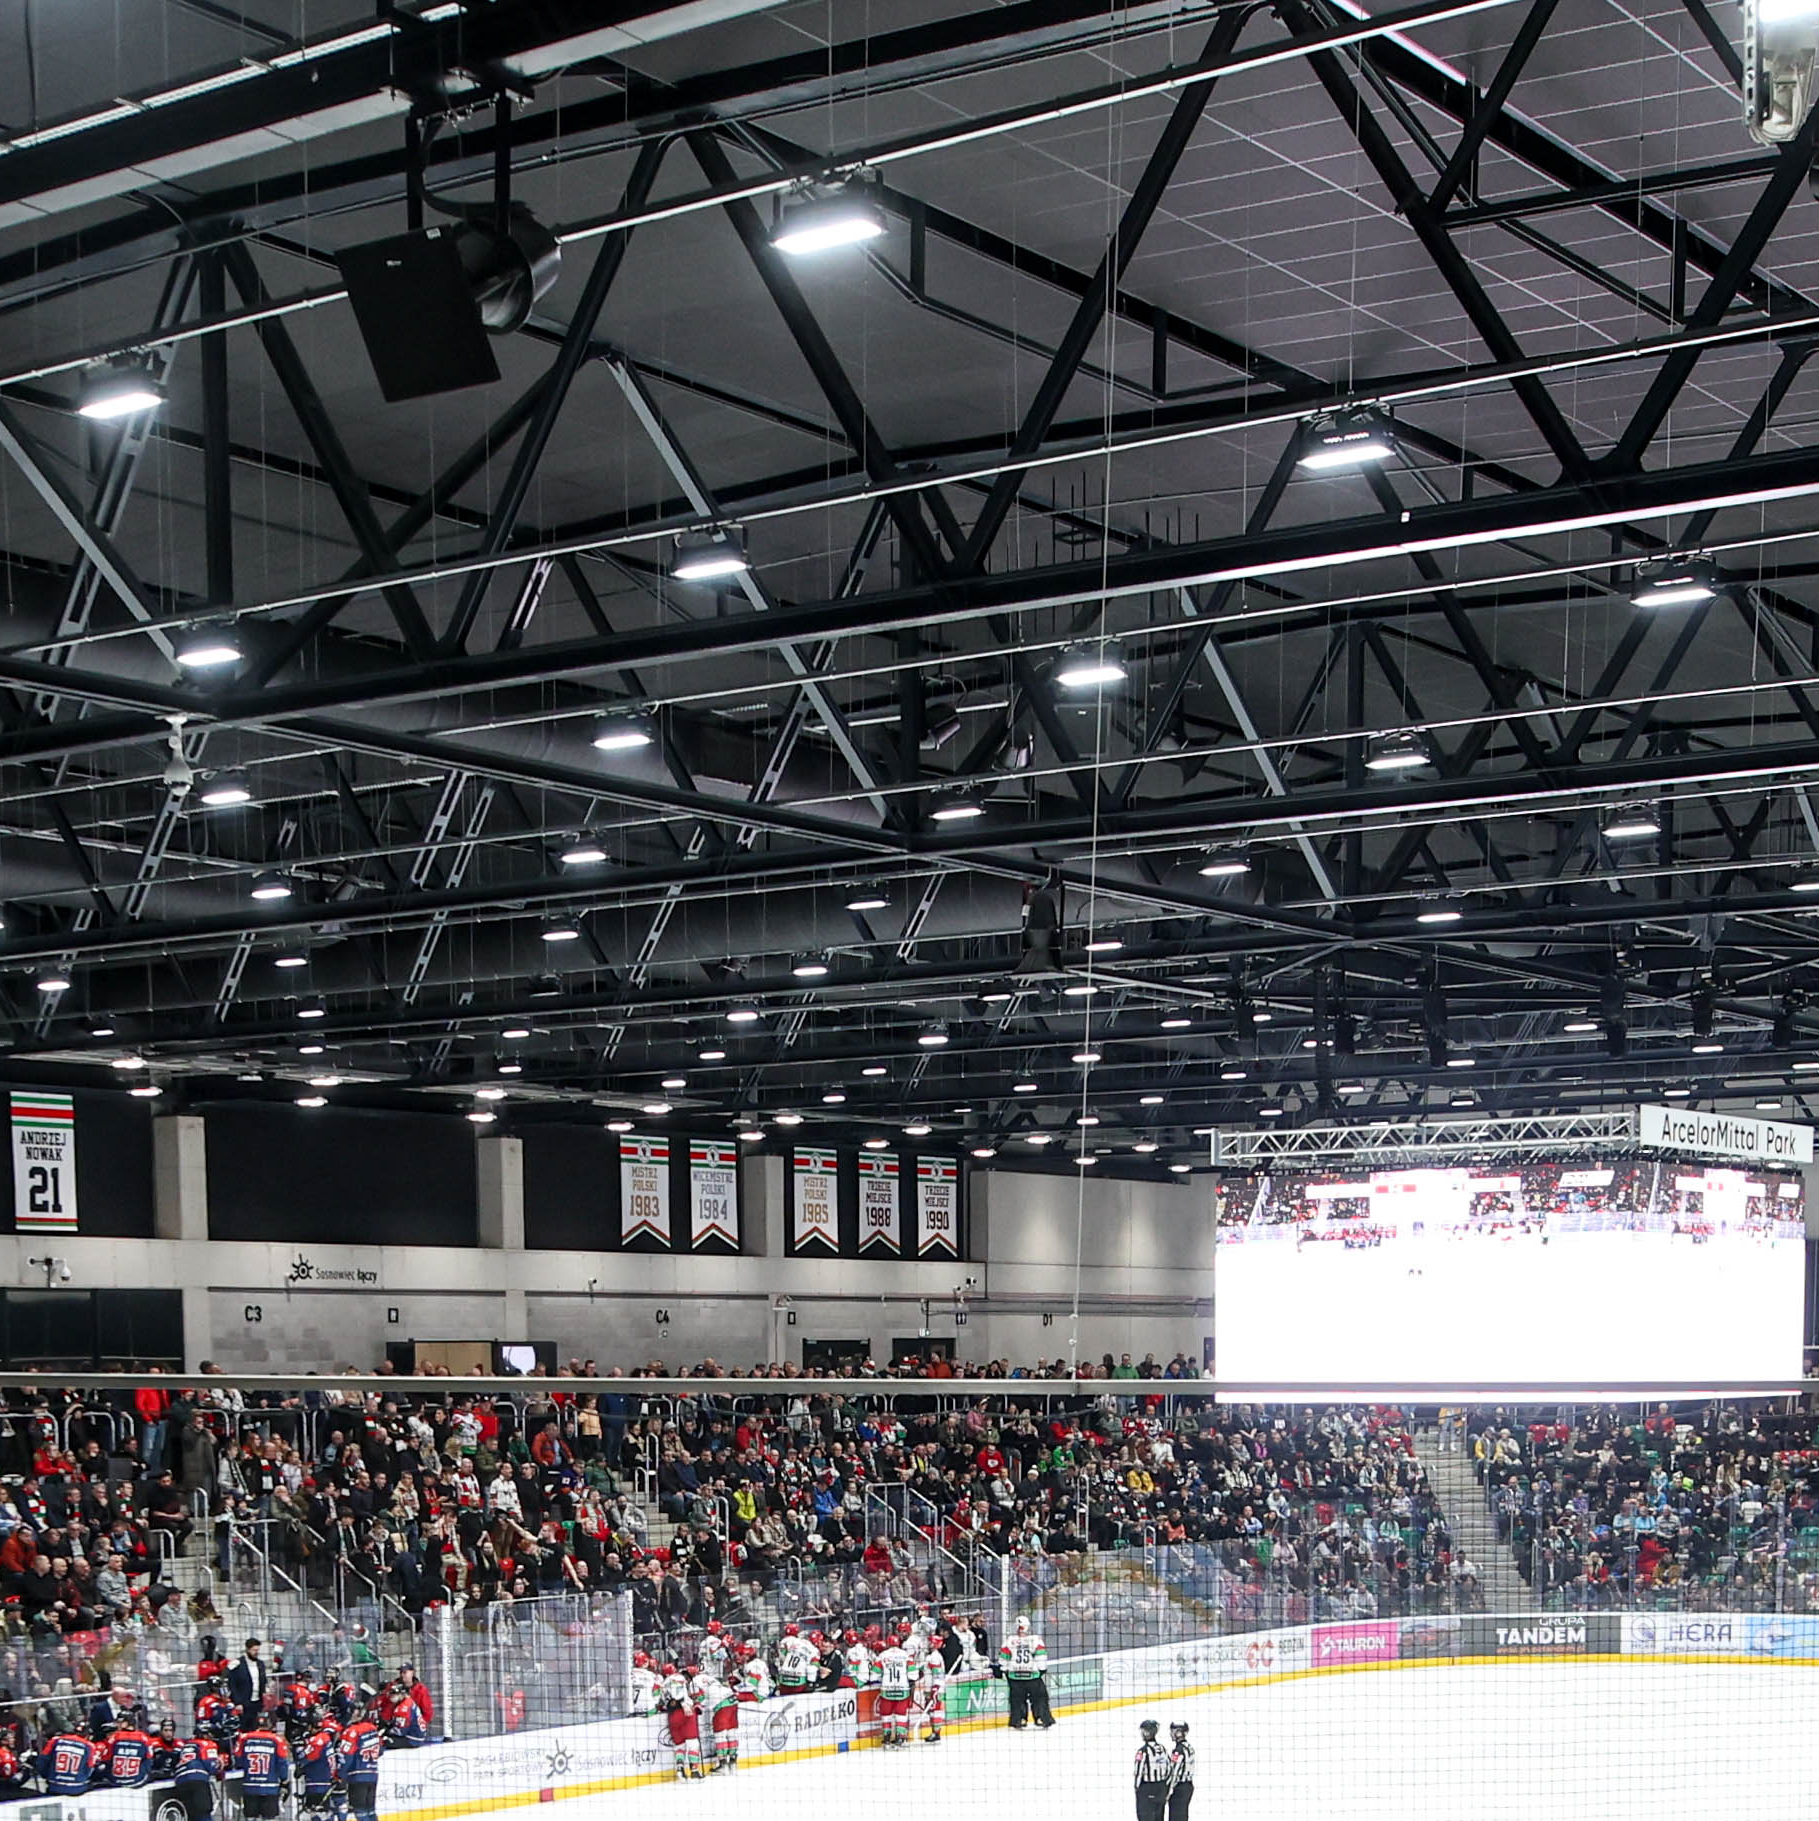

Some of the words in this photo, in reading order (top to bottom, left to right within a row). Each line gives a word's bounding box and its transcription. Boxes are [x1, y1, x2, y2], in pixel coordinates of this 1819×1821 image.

[20, 1131, 67, 1147] ANDRZEJ
[1661, 1113, 1760, 1151] ArcelorMittal
[1766, 1127, 1796, 1156] Park
[26, 1148, 63, 1162] NOWAK
[631, 1166, 658, 1179] MISTRZ
[28, 1166, 63, 1213] 21
[633, 1179, 657, 1192] POLSKI
[701, 1184, 726, 1196] POLSKI
[803, 1176, 828, 1188] MISTRZ
[804, 1188, 828, 1200] POLSKI
[630, 1195, 660, 1217] 1983
[699, 1198, 728, 1220] 1984
[802, 1203, 829, 1224] 1985
[865, 1206, 892, 1227] 1988
[925, 1210, 950, 1230] 1990
[245, 1305, 262, 1322] C3
[656, 1310, 670, 1324] C4
[1042, 1314, 1053, 1326] D1
[1336, 1635, 1385, 1652] TAURON
[1496, 1627, 1586, 1645] TANDEM
[1016, 1649, 1030, 1665] 55
[888, 1666, 901, 1684] 14
[247, 1752, 271, 1775] 31
[631, 1748, 658, 1767] łączy
[393, 1783, 424, 1801] łączy
